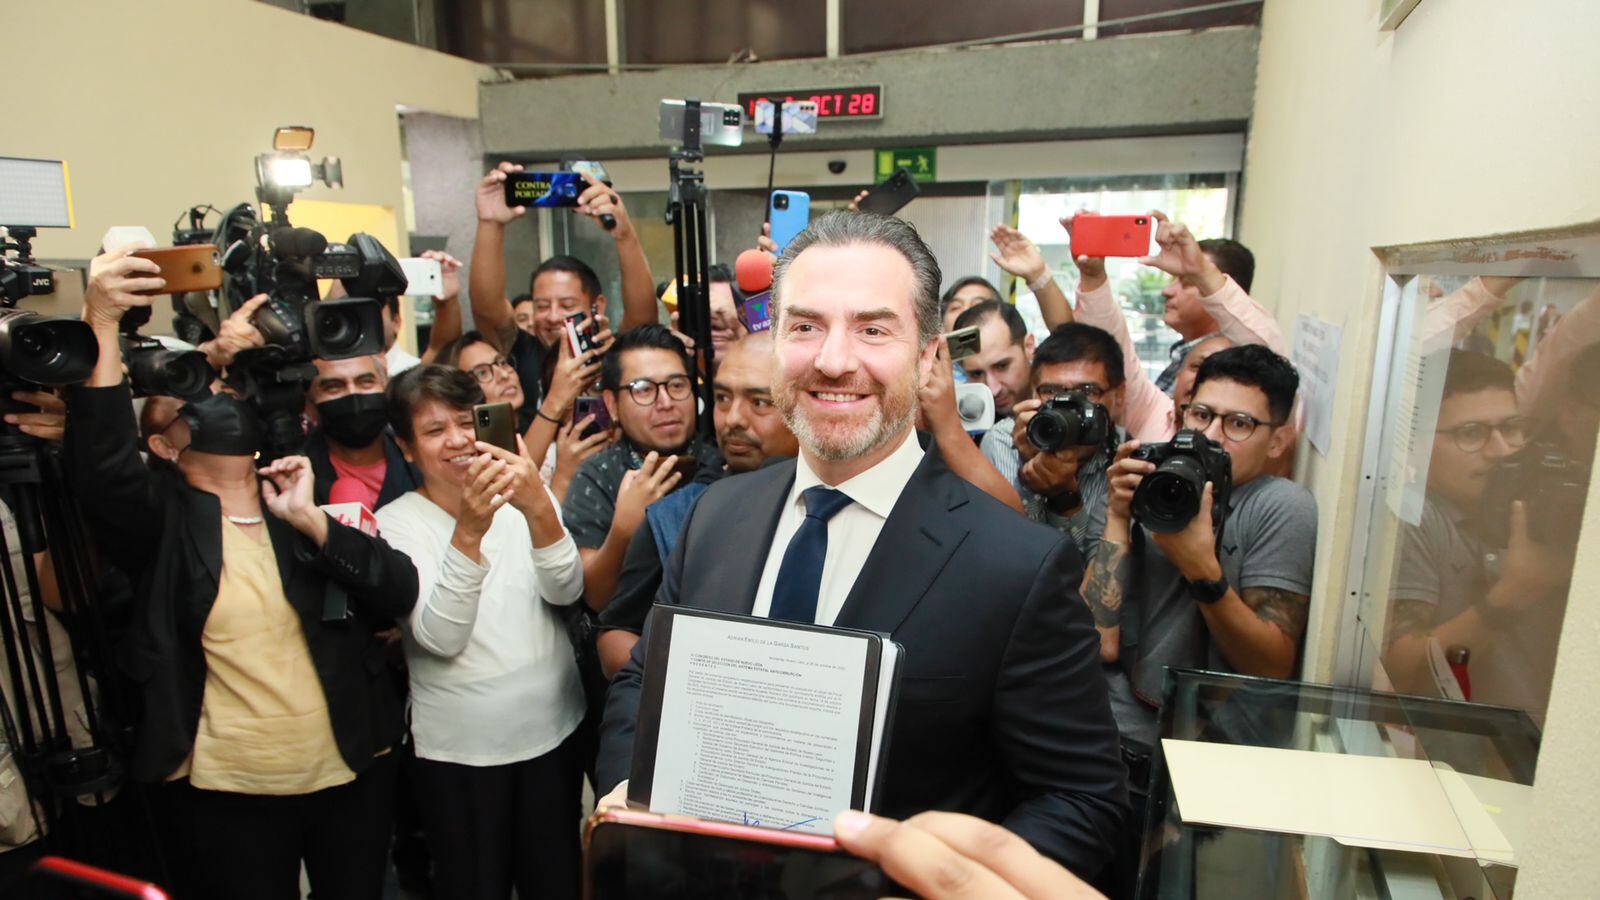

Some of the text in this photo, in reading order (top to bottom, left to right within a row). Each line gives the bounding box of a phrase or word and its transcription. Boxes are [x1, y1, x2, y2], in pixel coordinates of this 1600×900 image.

[848, 93, 875, 114] 28
[515, 181, 551, 190] CONTRA
[32, 278, 50, 286] JVC
[752, 322, 762, 331] tv
